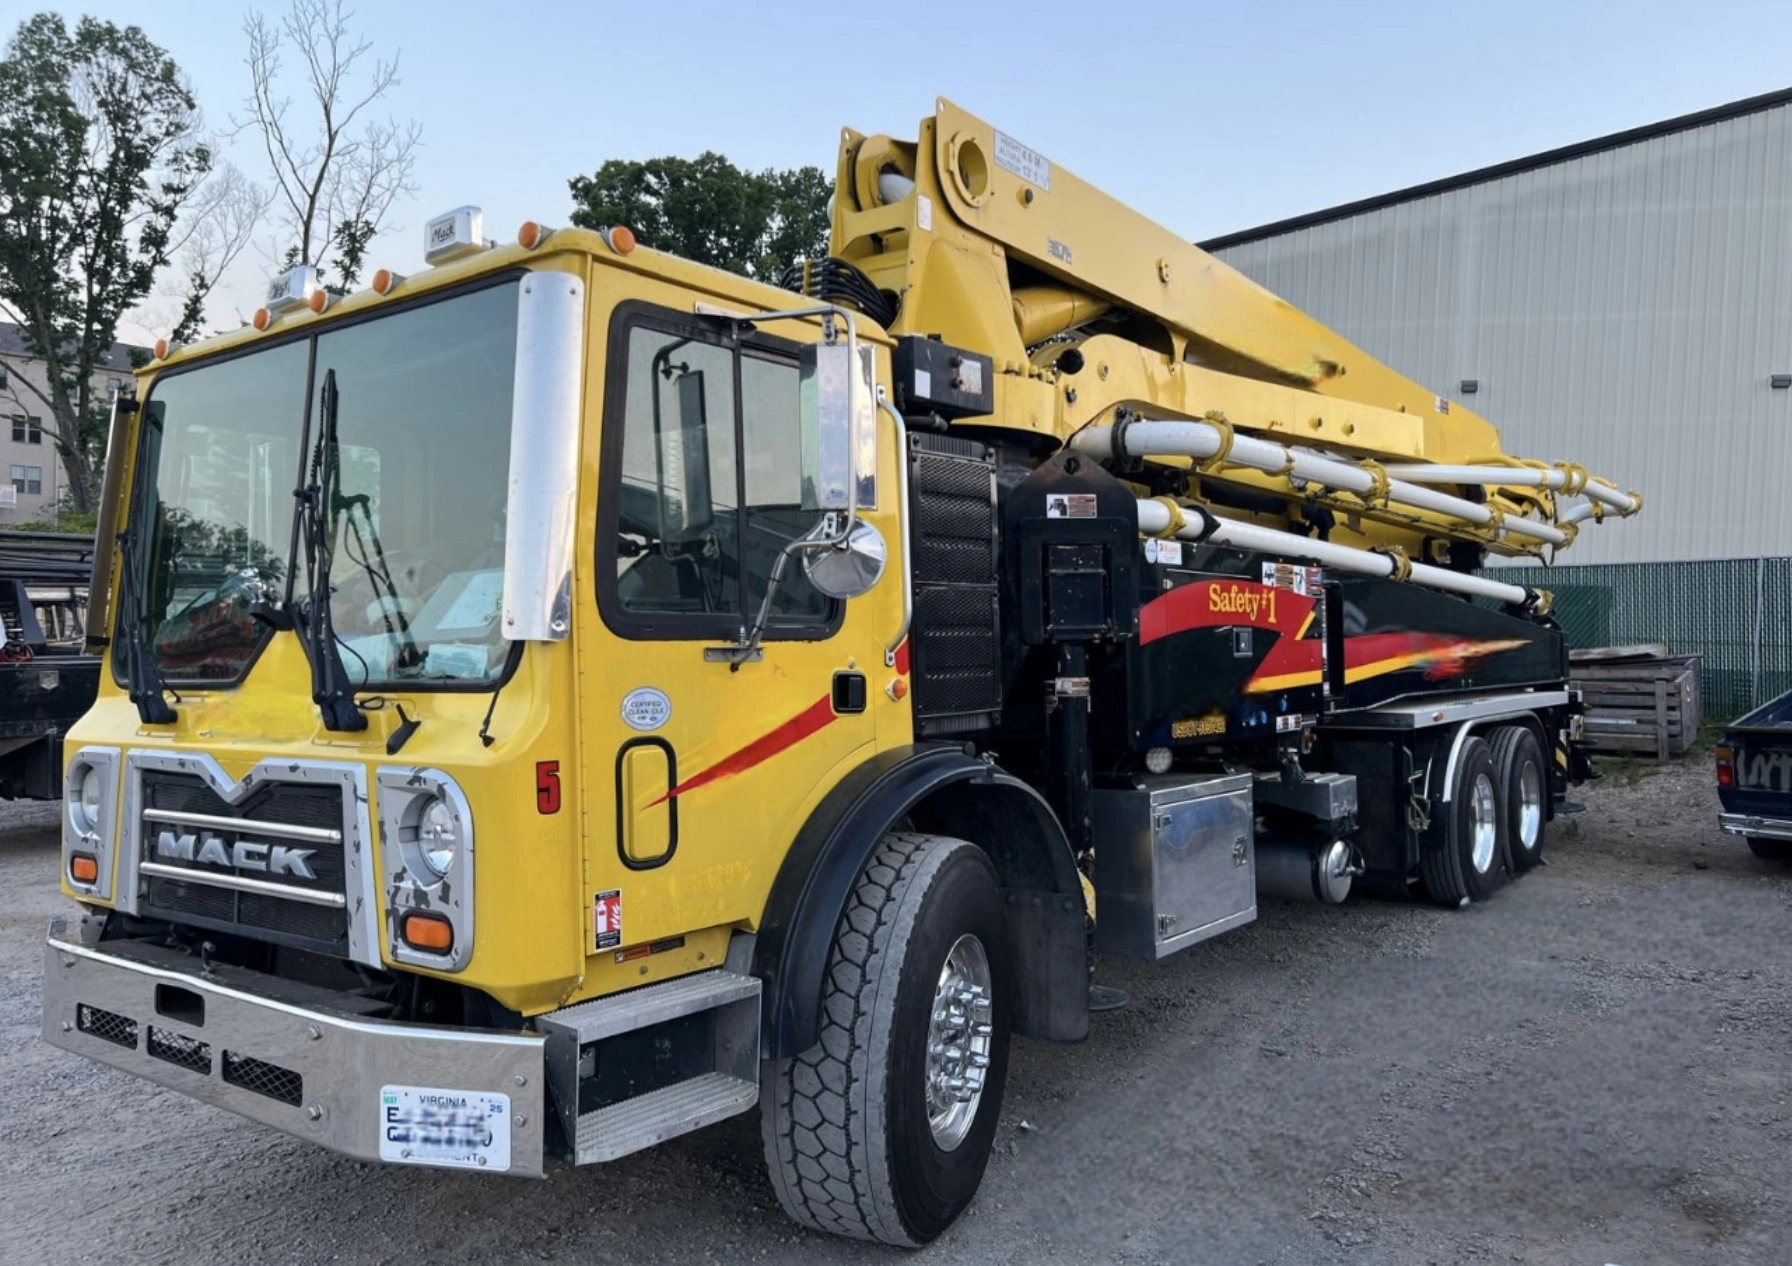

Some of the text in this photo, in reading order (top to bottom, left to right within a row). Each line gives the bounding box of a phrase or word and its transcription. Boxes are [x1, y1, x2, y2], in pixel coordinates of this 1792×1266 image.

[1209, 583, 1260, 621] Safety
[536, 760, 562, 815] 5
[157, 831, 318, 880] MACK
[419, 1095, 468, 1107] VIRGINIA
[489, 1104, 503, 1114] 25
